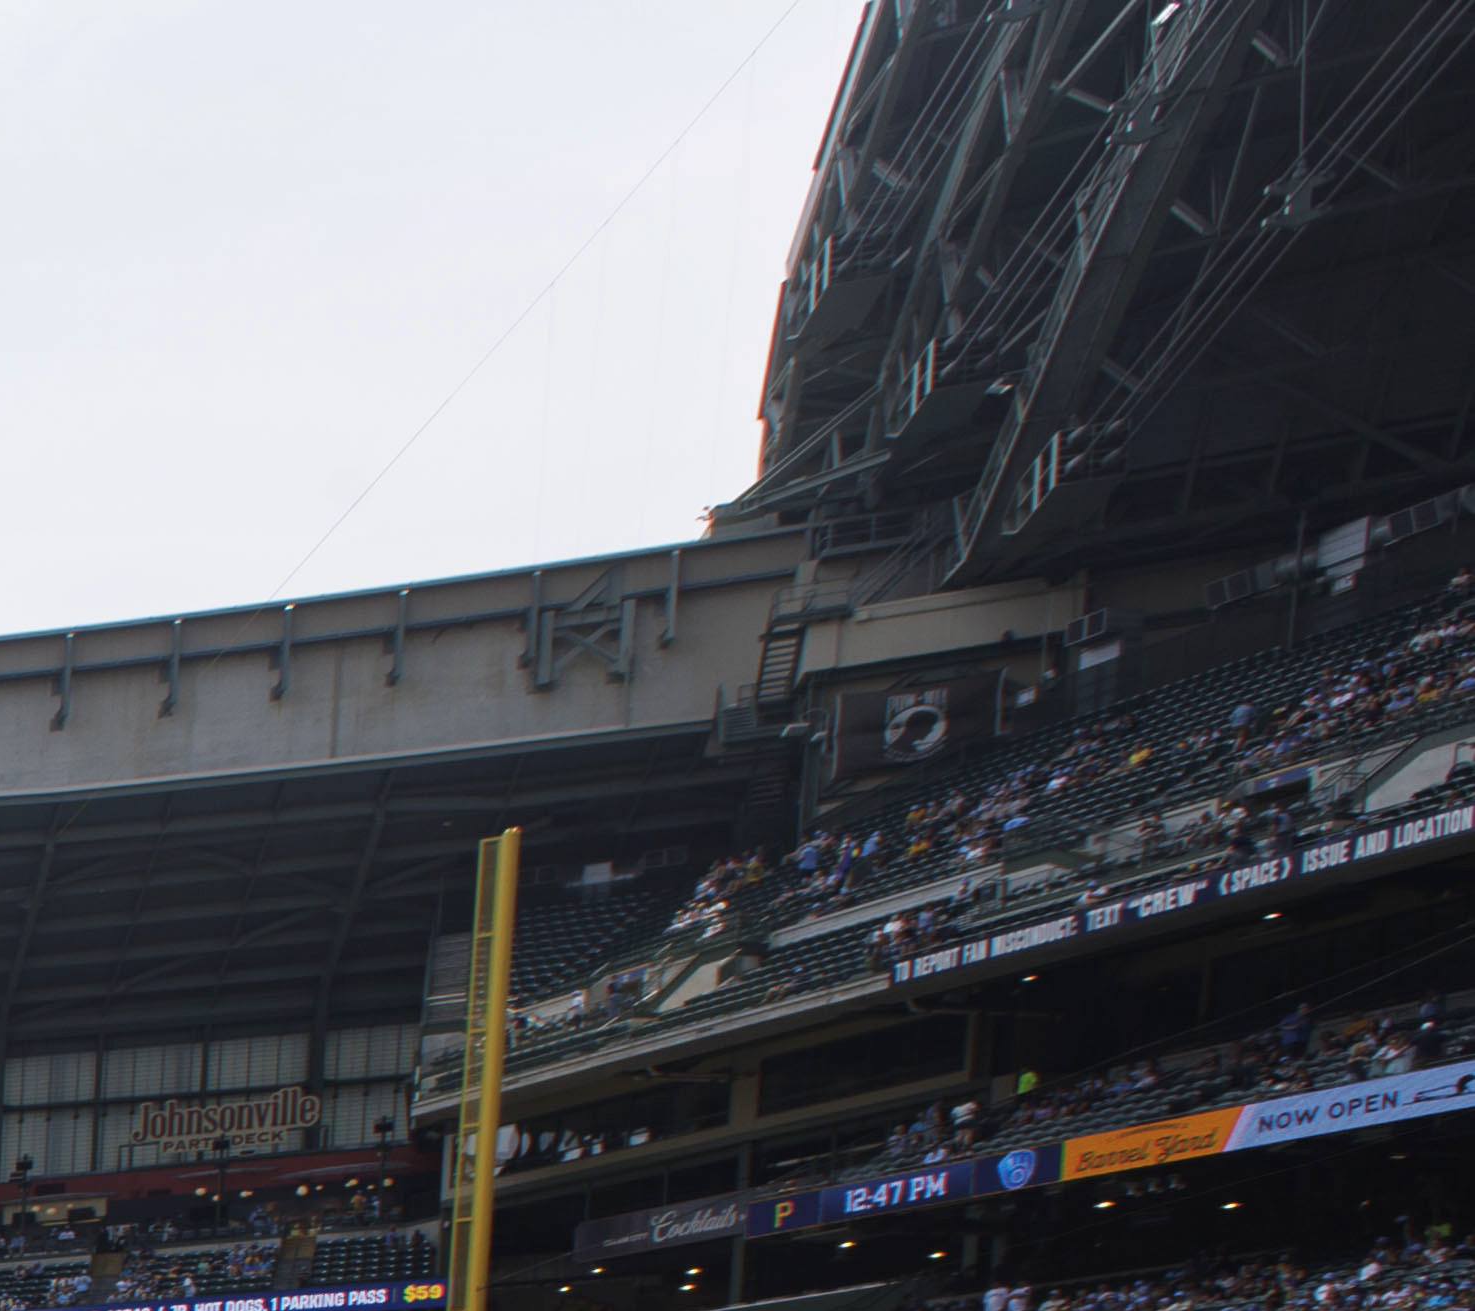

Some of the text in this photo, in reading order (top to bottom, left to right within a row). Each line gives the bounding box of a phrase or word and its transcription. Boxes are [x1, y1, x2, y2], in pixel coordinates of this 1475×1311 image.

[133, 1085, 322, 1143] Johnsonville
[1258, 1090, 1399, 1133] NOW OPEN
[908, 1171, 948, 1203] PM
